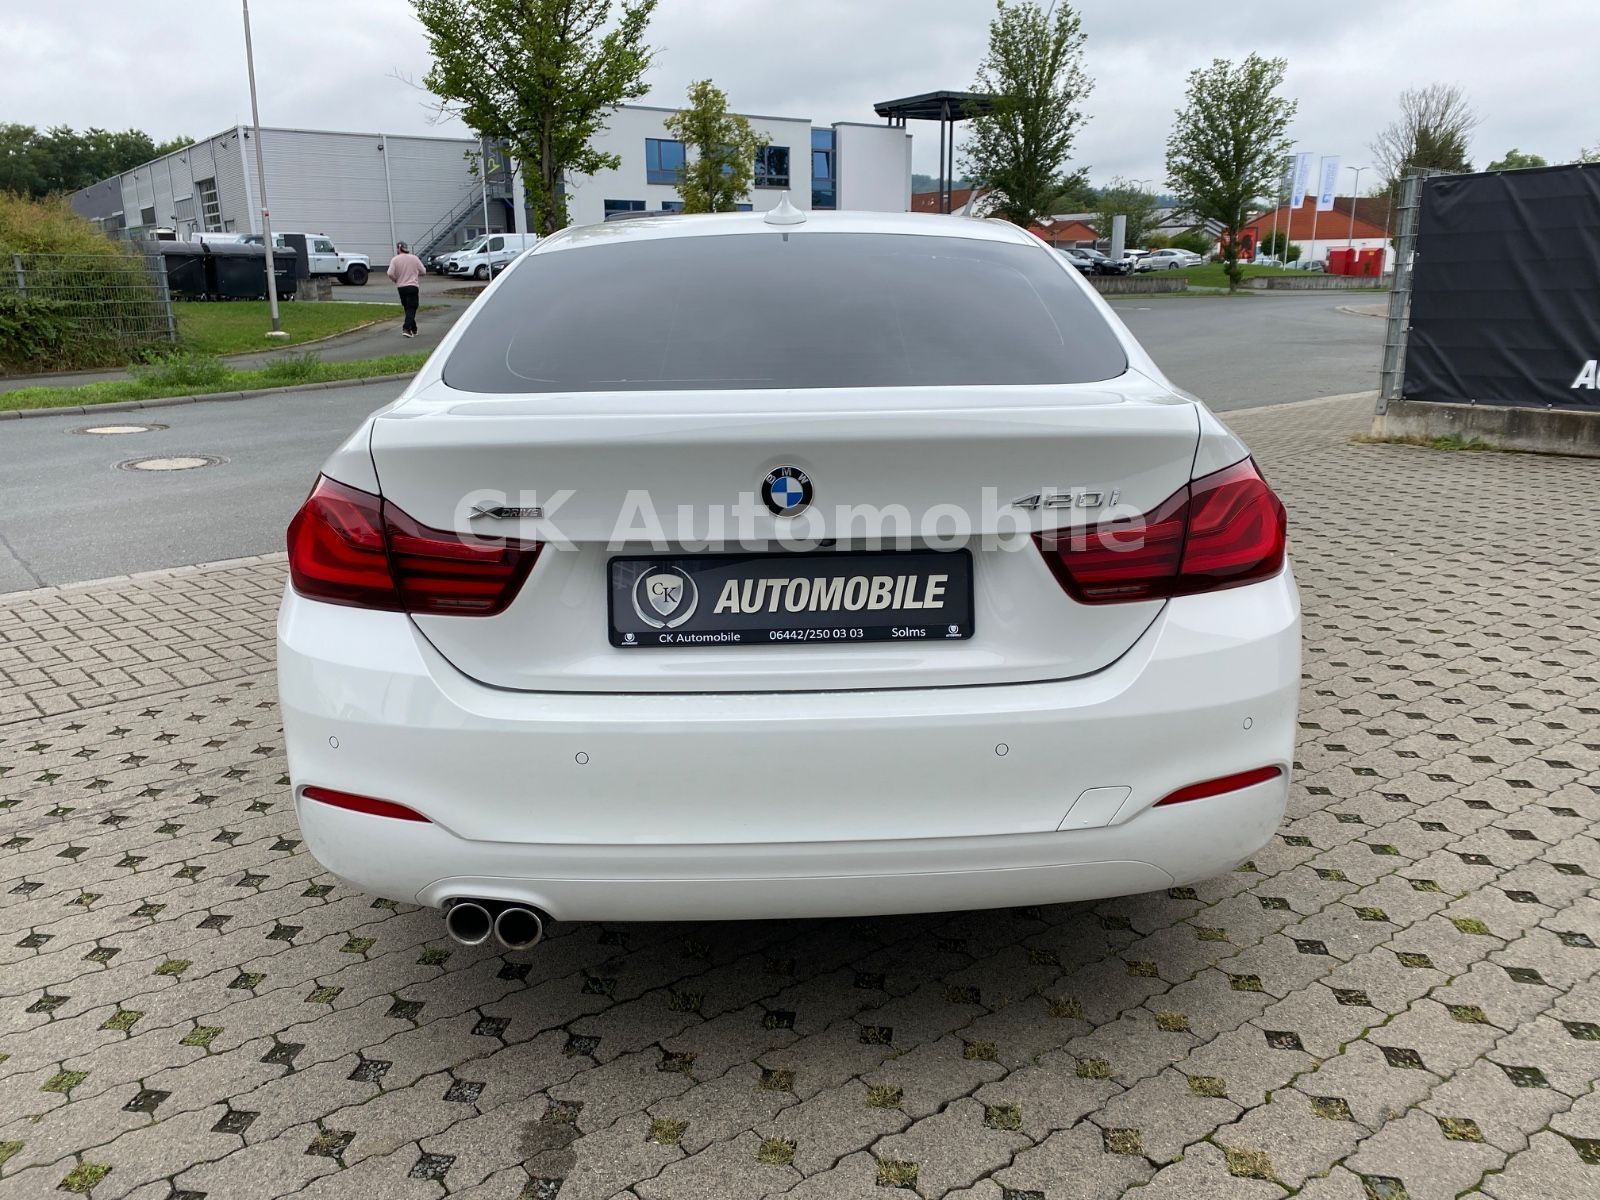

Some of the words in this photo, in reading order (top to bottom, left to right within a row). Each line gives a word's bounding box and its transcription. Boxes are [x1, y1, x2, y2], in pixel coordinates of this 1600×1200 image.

[1571, 359, 1600, 390] A
[766, 467, 809, 485] BMW
[1011, 487, 1121, 511] 420i
[652, 582, 678, 603] CK
[713, 574, 949, 614] AUTOMOBILE
[659, 633, 674, 643] CK
[676, 631, 741, 643] Automobile
[769, 628, 830, 641] 06442/250
[833, 628, 847, 639] 03
[849, 628, 864, 638] 03
[891, 626, 926, 638] Solms
